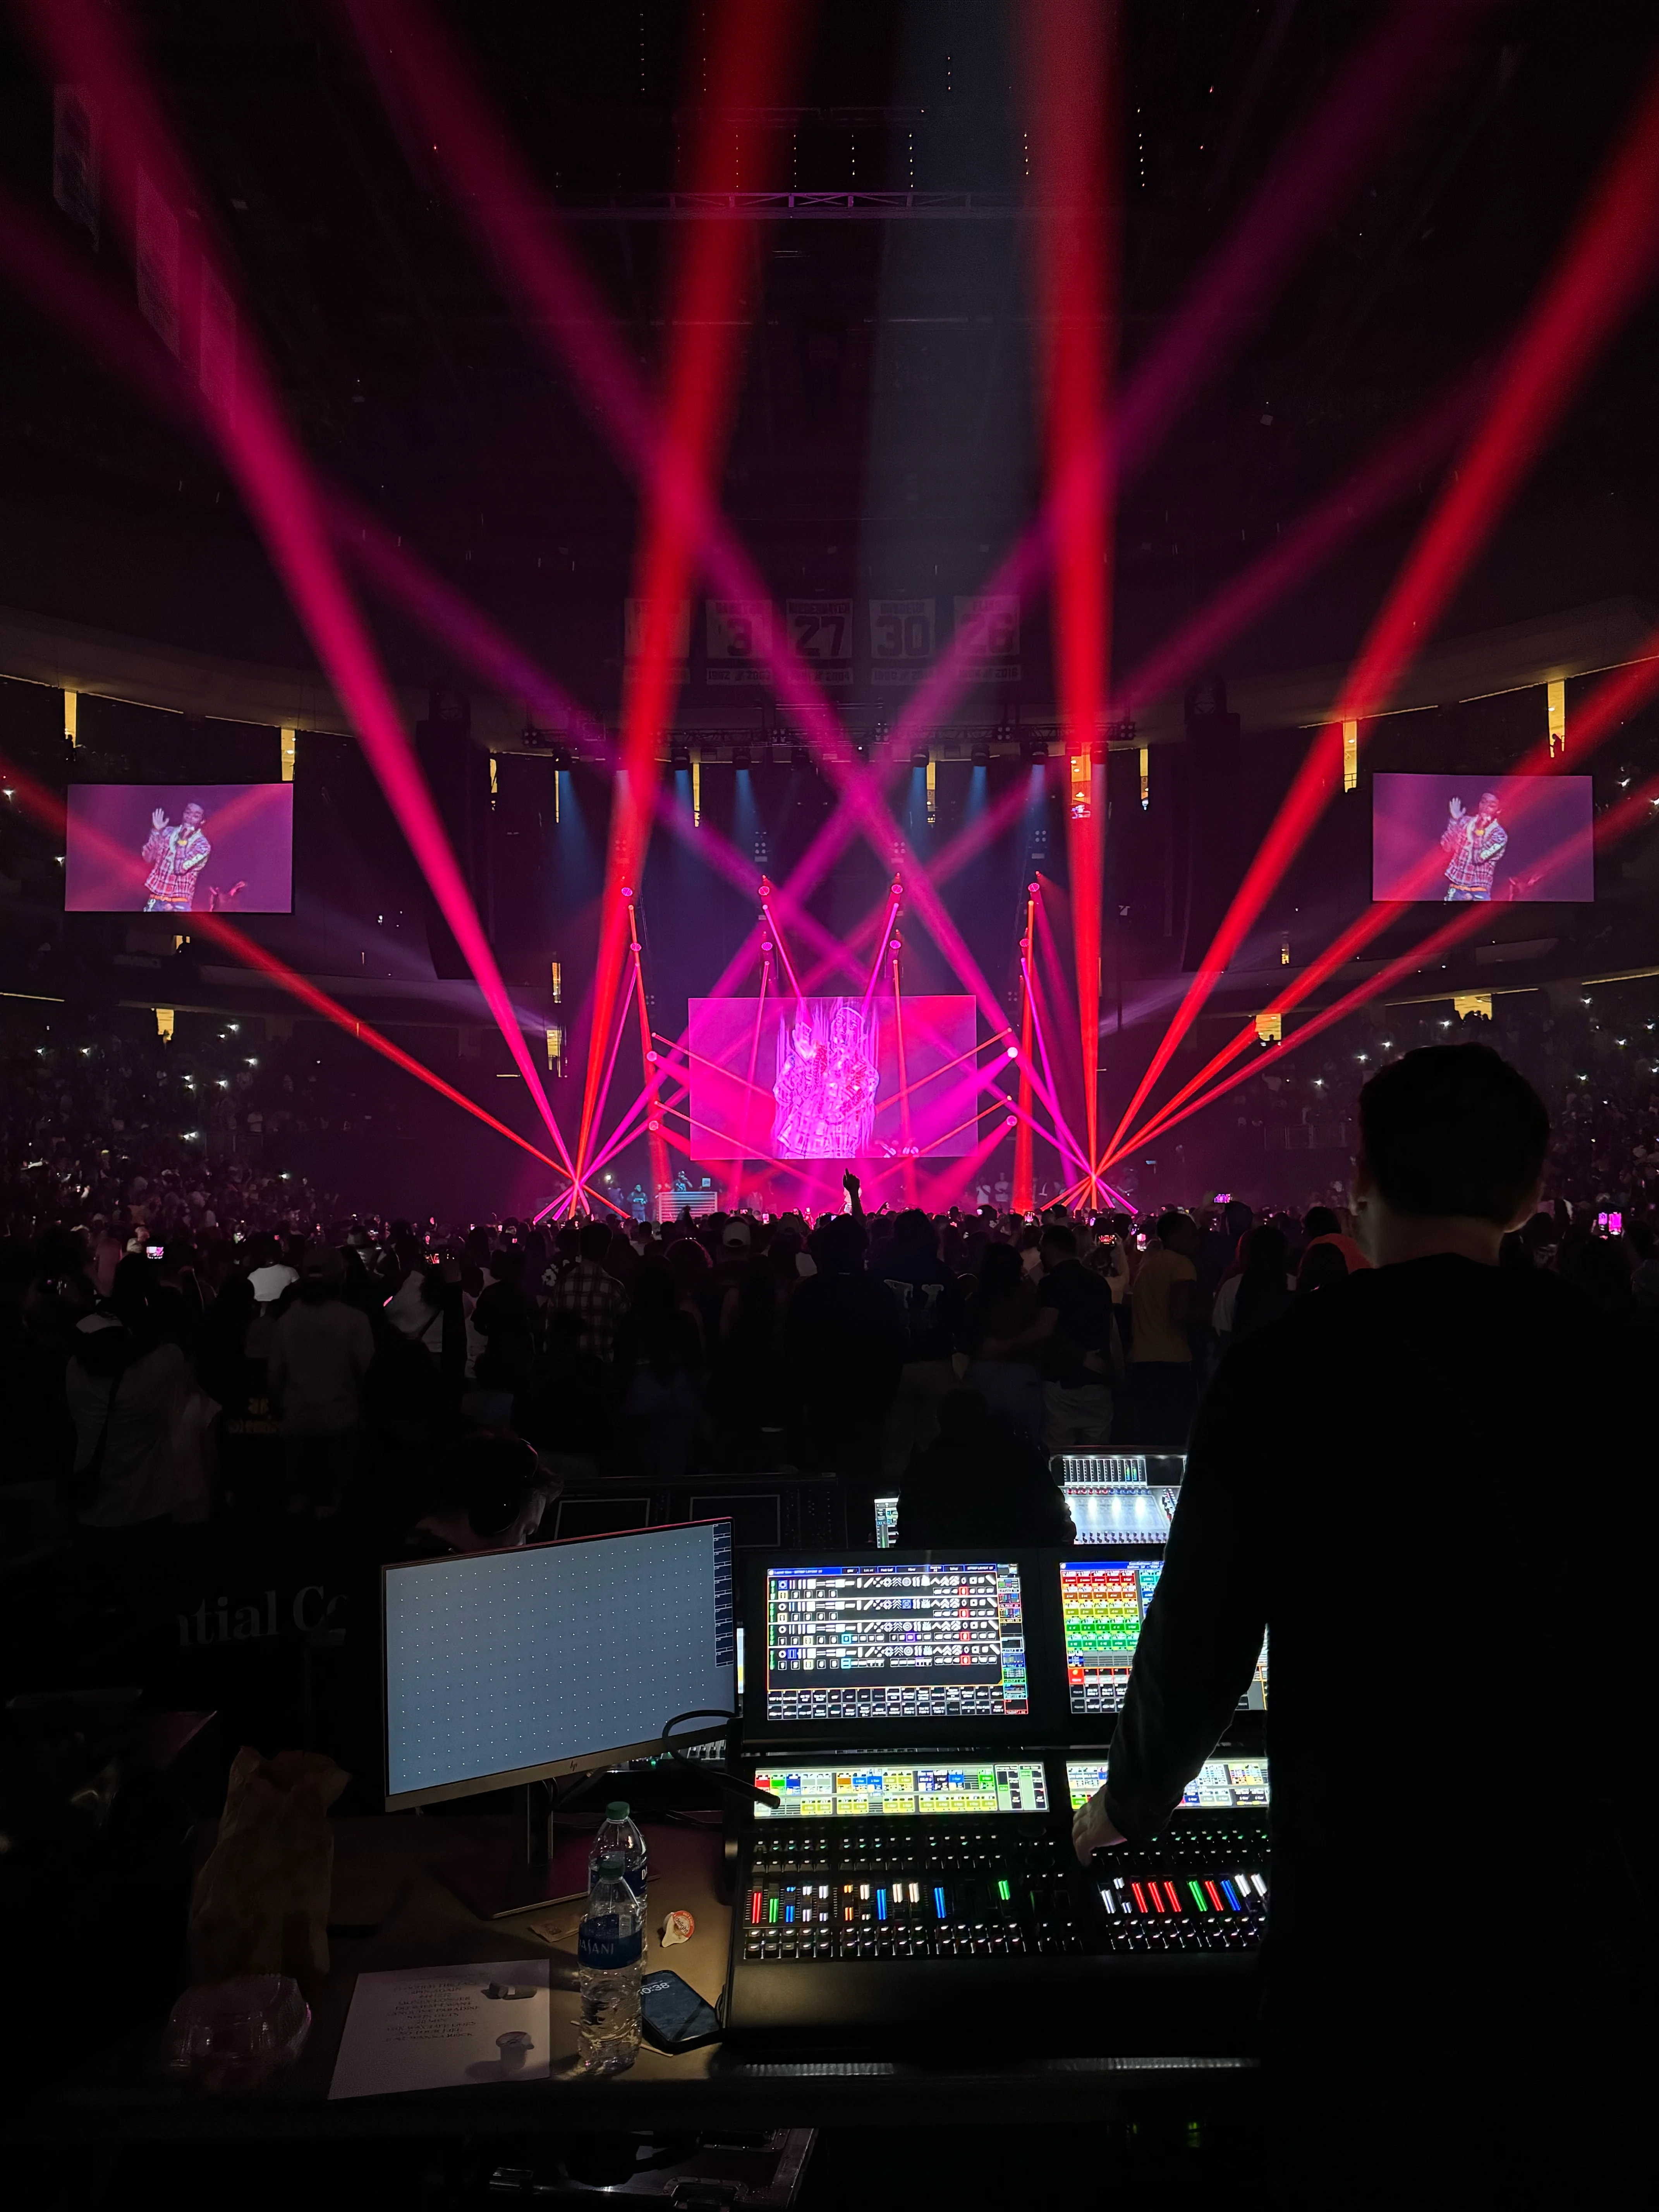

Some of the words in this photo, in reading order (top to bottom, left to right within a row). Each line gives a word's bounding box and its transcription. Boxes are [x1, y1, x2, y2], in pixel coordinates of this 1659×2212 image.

[795, 616, 845, 657] 27
[877, 615, 930, 656] 30
[962, 613, 1013, 653] 26
